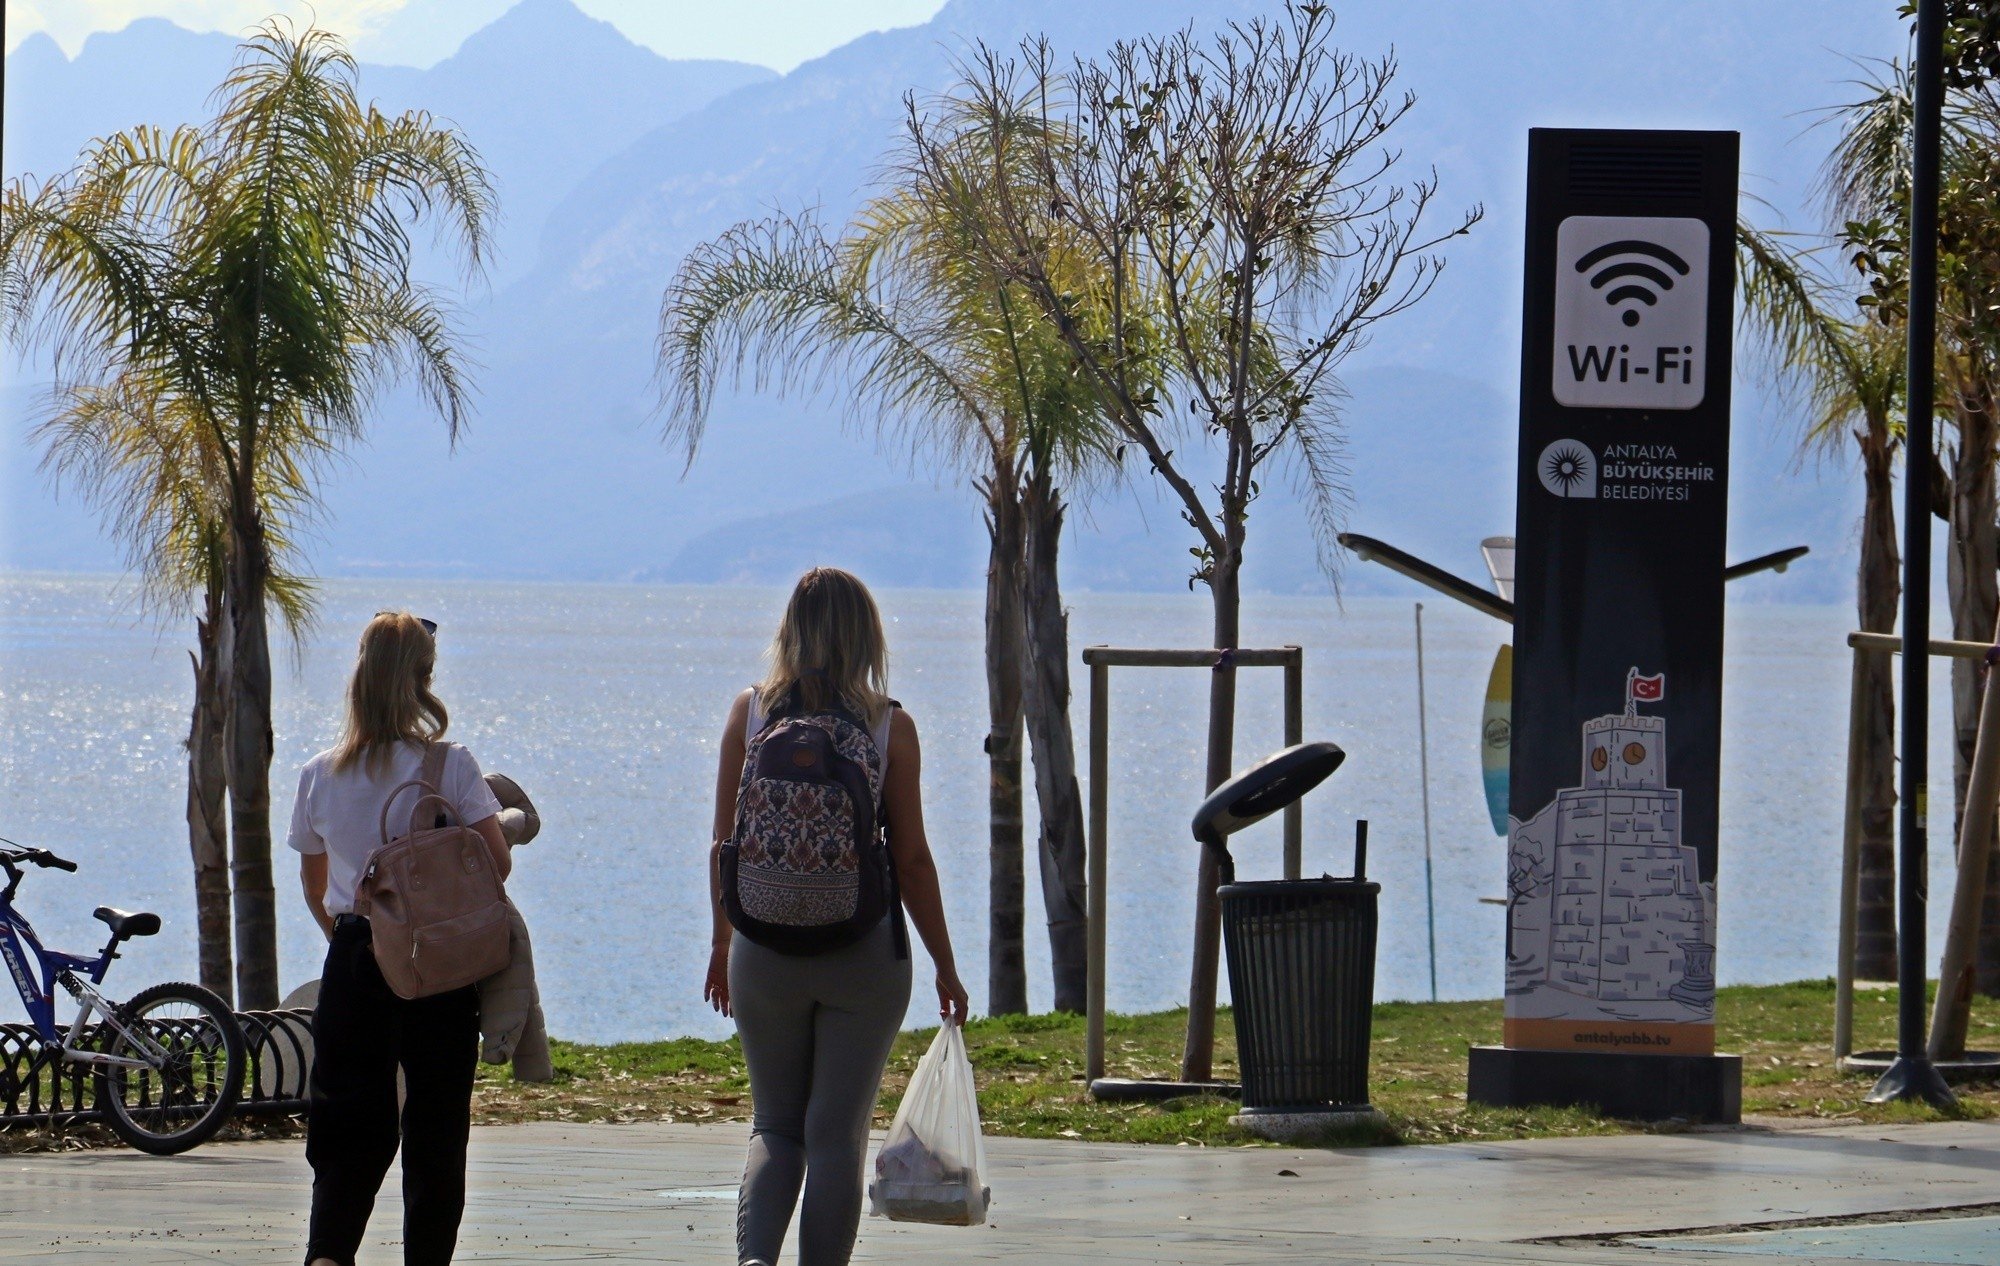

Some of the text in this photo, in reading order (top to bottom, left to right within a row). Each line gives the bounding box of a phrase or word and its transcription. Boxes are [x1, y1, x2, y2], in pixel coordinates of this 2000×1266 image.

[1568, 344, 1693, 385] Wi-Fi
[1603, 444, 1678, 459] ANTALYA
[1603, 461, 1714, 483] BÜYÜKŞEHİR
[1603, 483, 1689, 500] BELEDİYESİ
[0, 937, 35, 1004] LARSEN
[1574, 1031, 1672, 1047] antalyabb.tv
